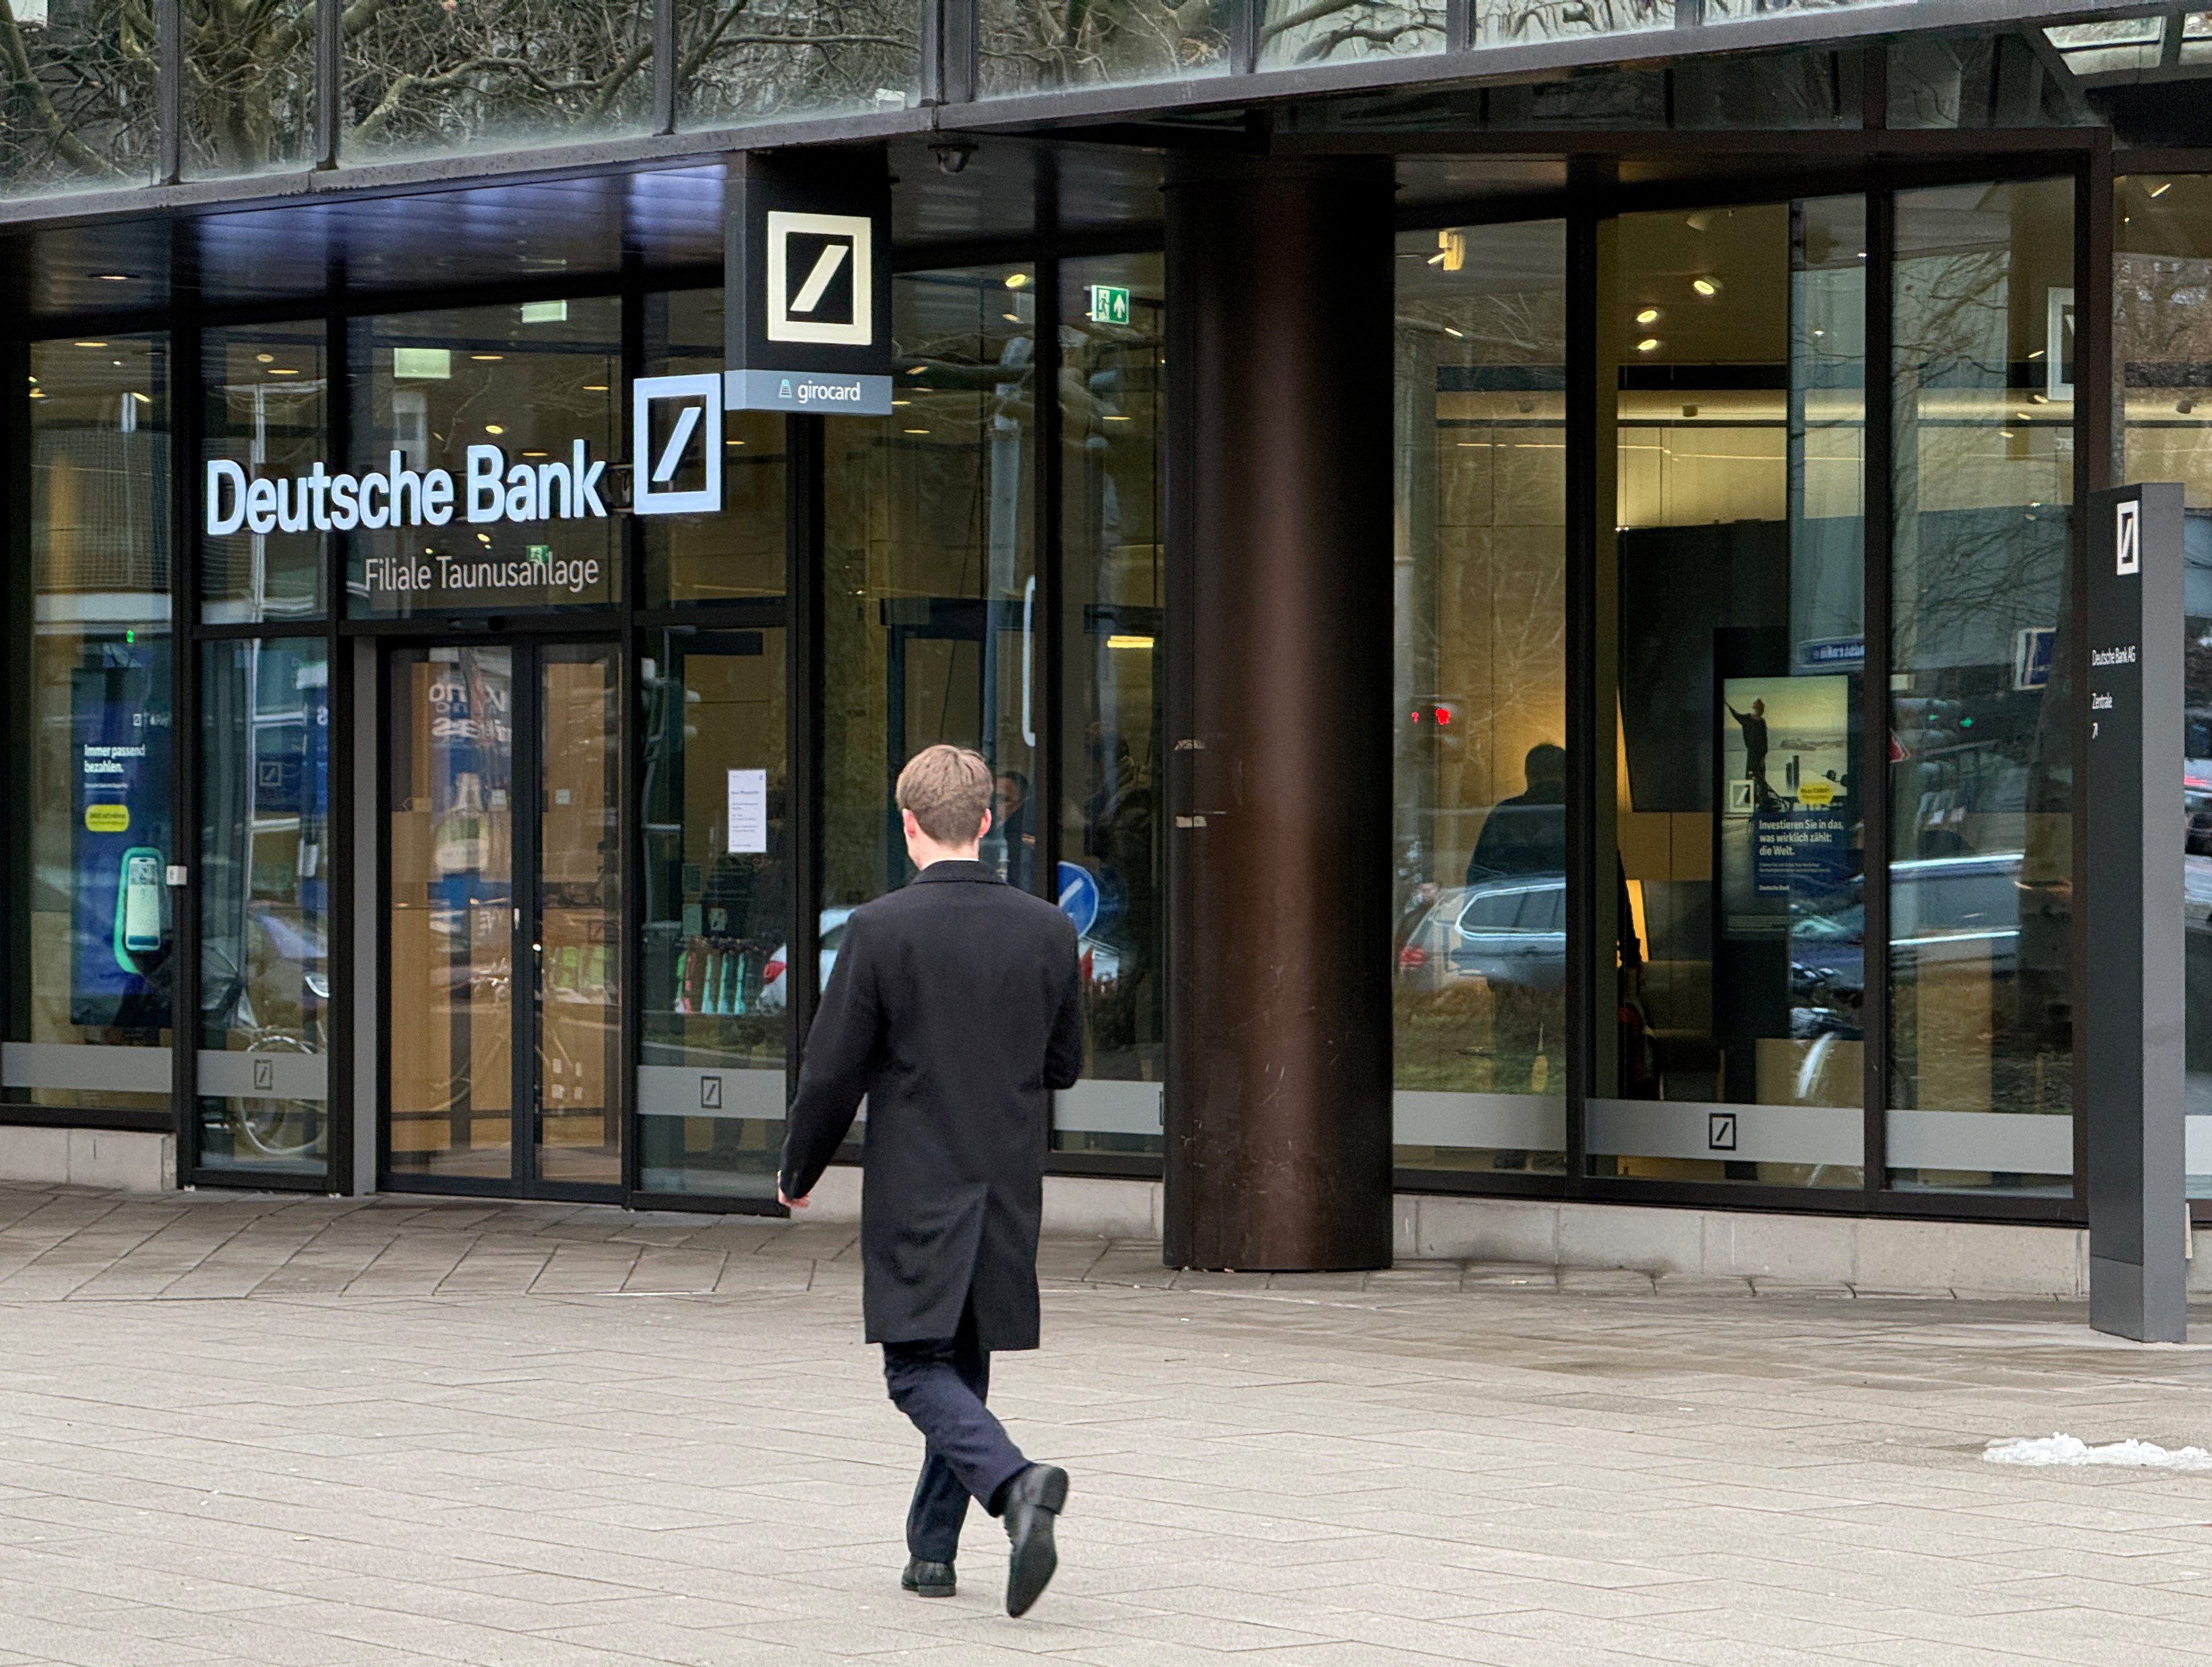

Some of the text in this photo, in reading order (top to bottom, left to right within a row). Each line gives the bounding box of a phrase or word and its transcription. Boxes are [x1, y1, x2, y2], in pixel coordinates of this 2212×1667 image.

[798, 380, 861, 404] girocard
[207, 439, 608, 536] Deutsche Bank
[366, 551, 599, 593] Filiale Taunusanlage
[2092, 645, 2136, 666] Deutsche Bank AG
[2092, 691, 2113, 710] Zentrale
[85, 743, 146, 759] Immer passend
[1759, 819, 1804, 830] Investieren
[1805, 819, 1817, 830] Sie
[1819, 819, 1826, 829] in
[1776, 832, 1809, 843] wirklich
[1759, 845, 1795, 856] die Welt.
